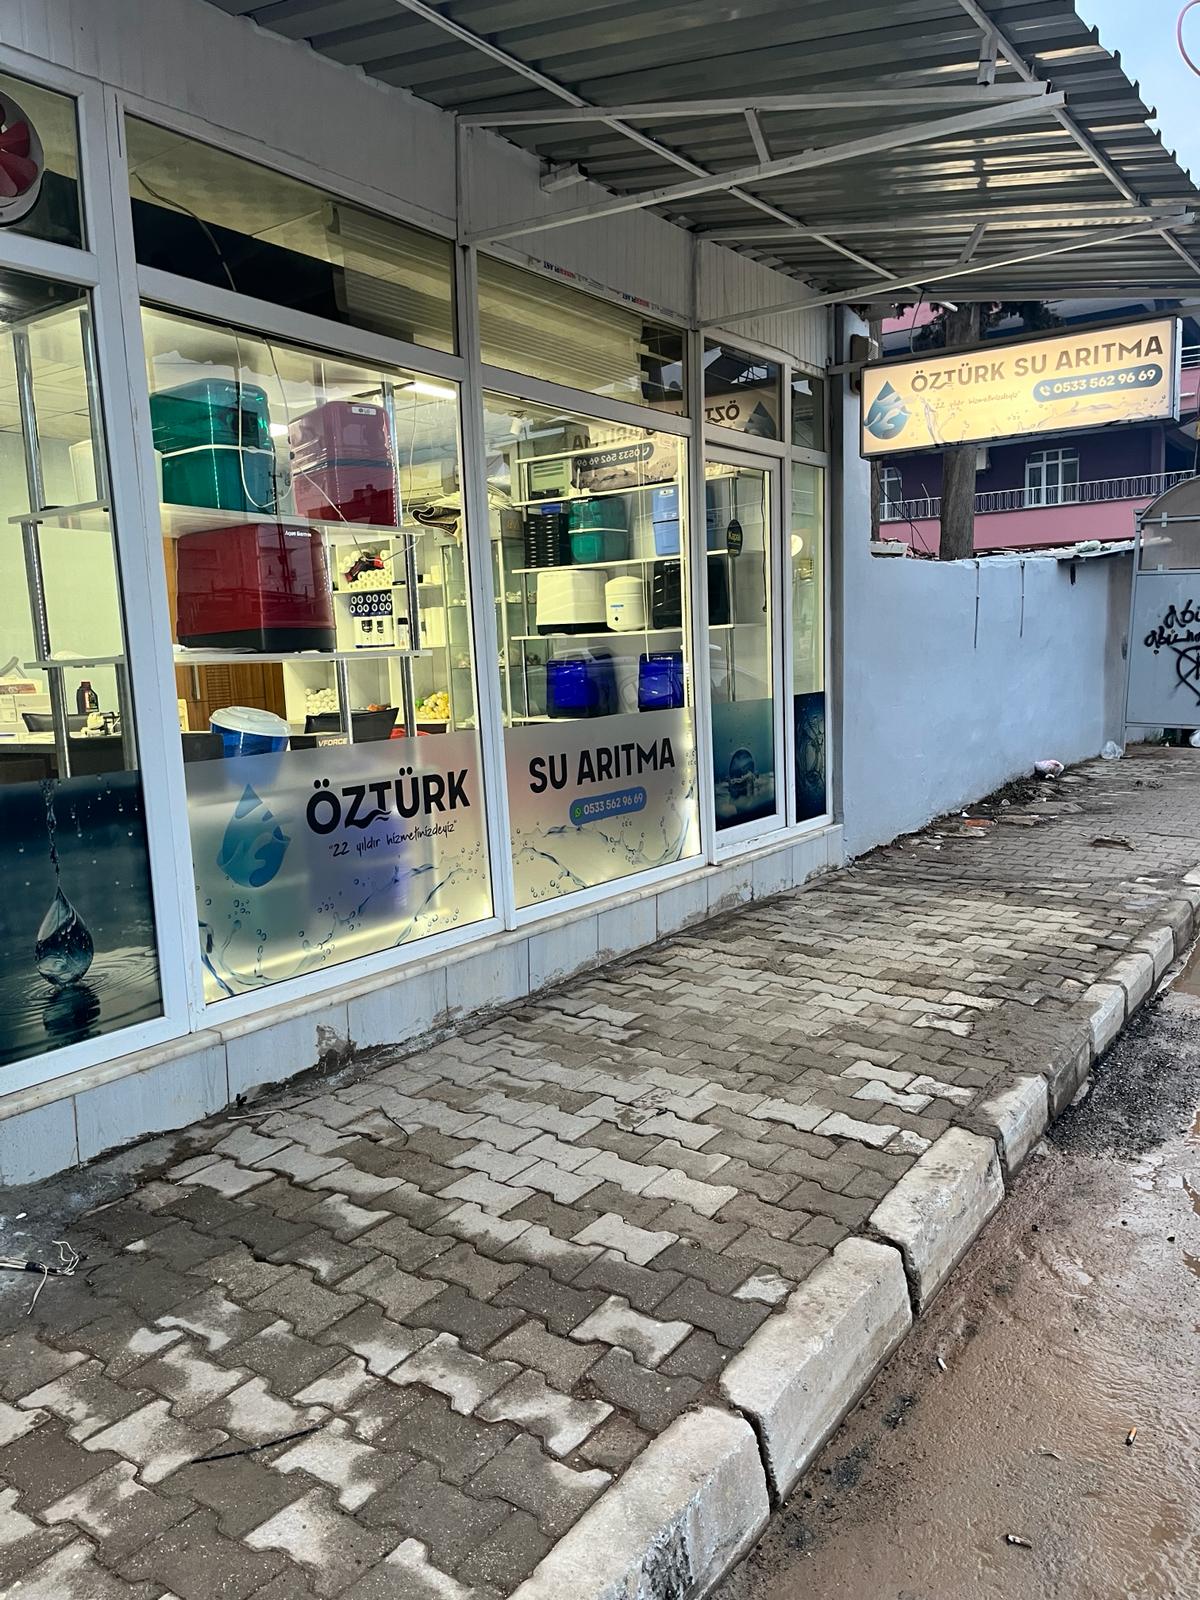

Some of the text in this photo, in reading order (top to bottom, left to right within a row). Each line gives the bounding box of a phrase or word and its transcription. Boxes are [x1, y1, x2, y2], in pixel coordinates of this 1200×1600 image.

[911, 335, 1163, 392] ÖZTÜRK SU ARITMA
[1053, 369, 1156, 394] 0533 562 96 69
[529, 737, 676, 794] SU ARITMA
[306, 766, 470, 835] ÖZTÜRK
[583, 792, 644, 815] 0533 562 96 69
[356, 836, 381, 858] yıldır
